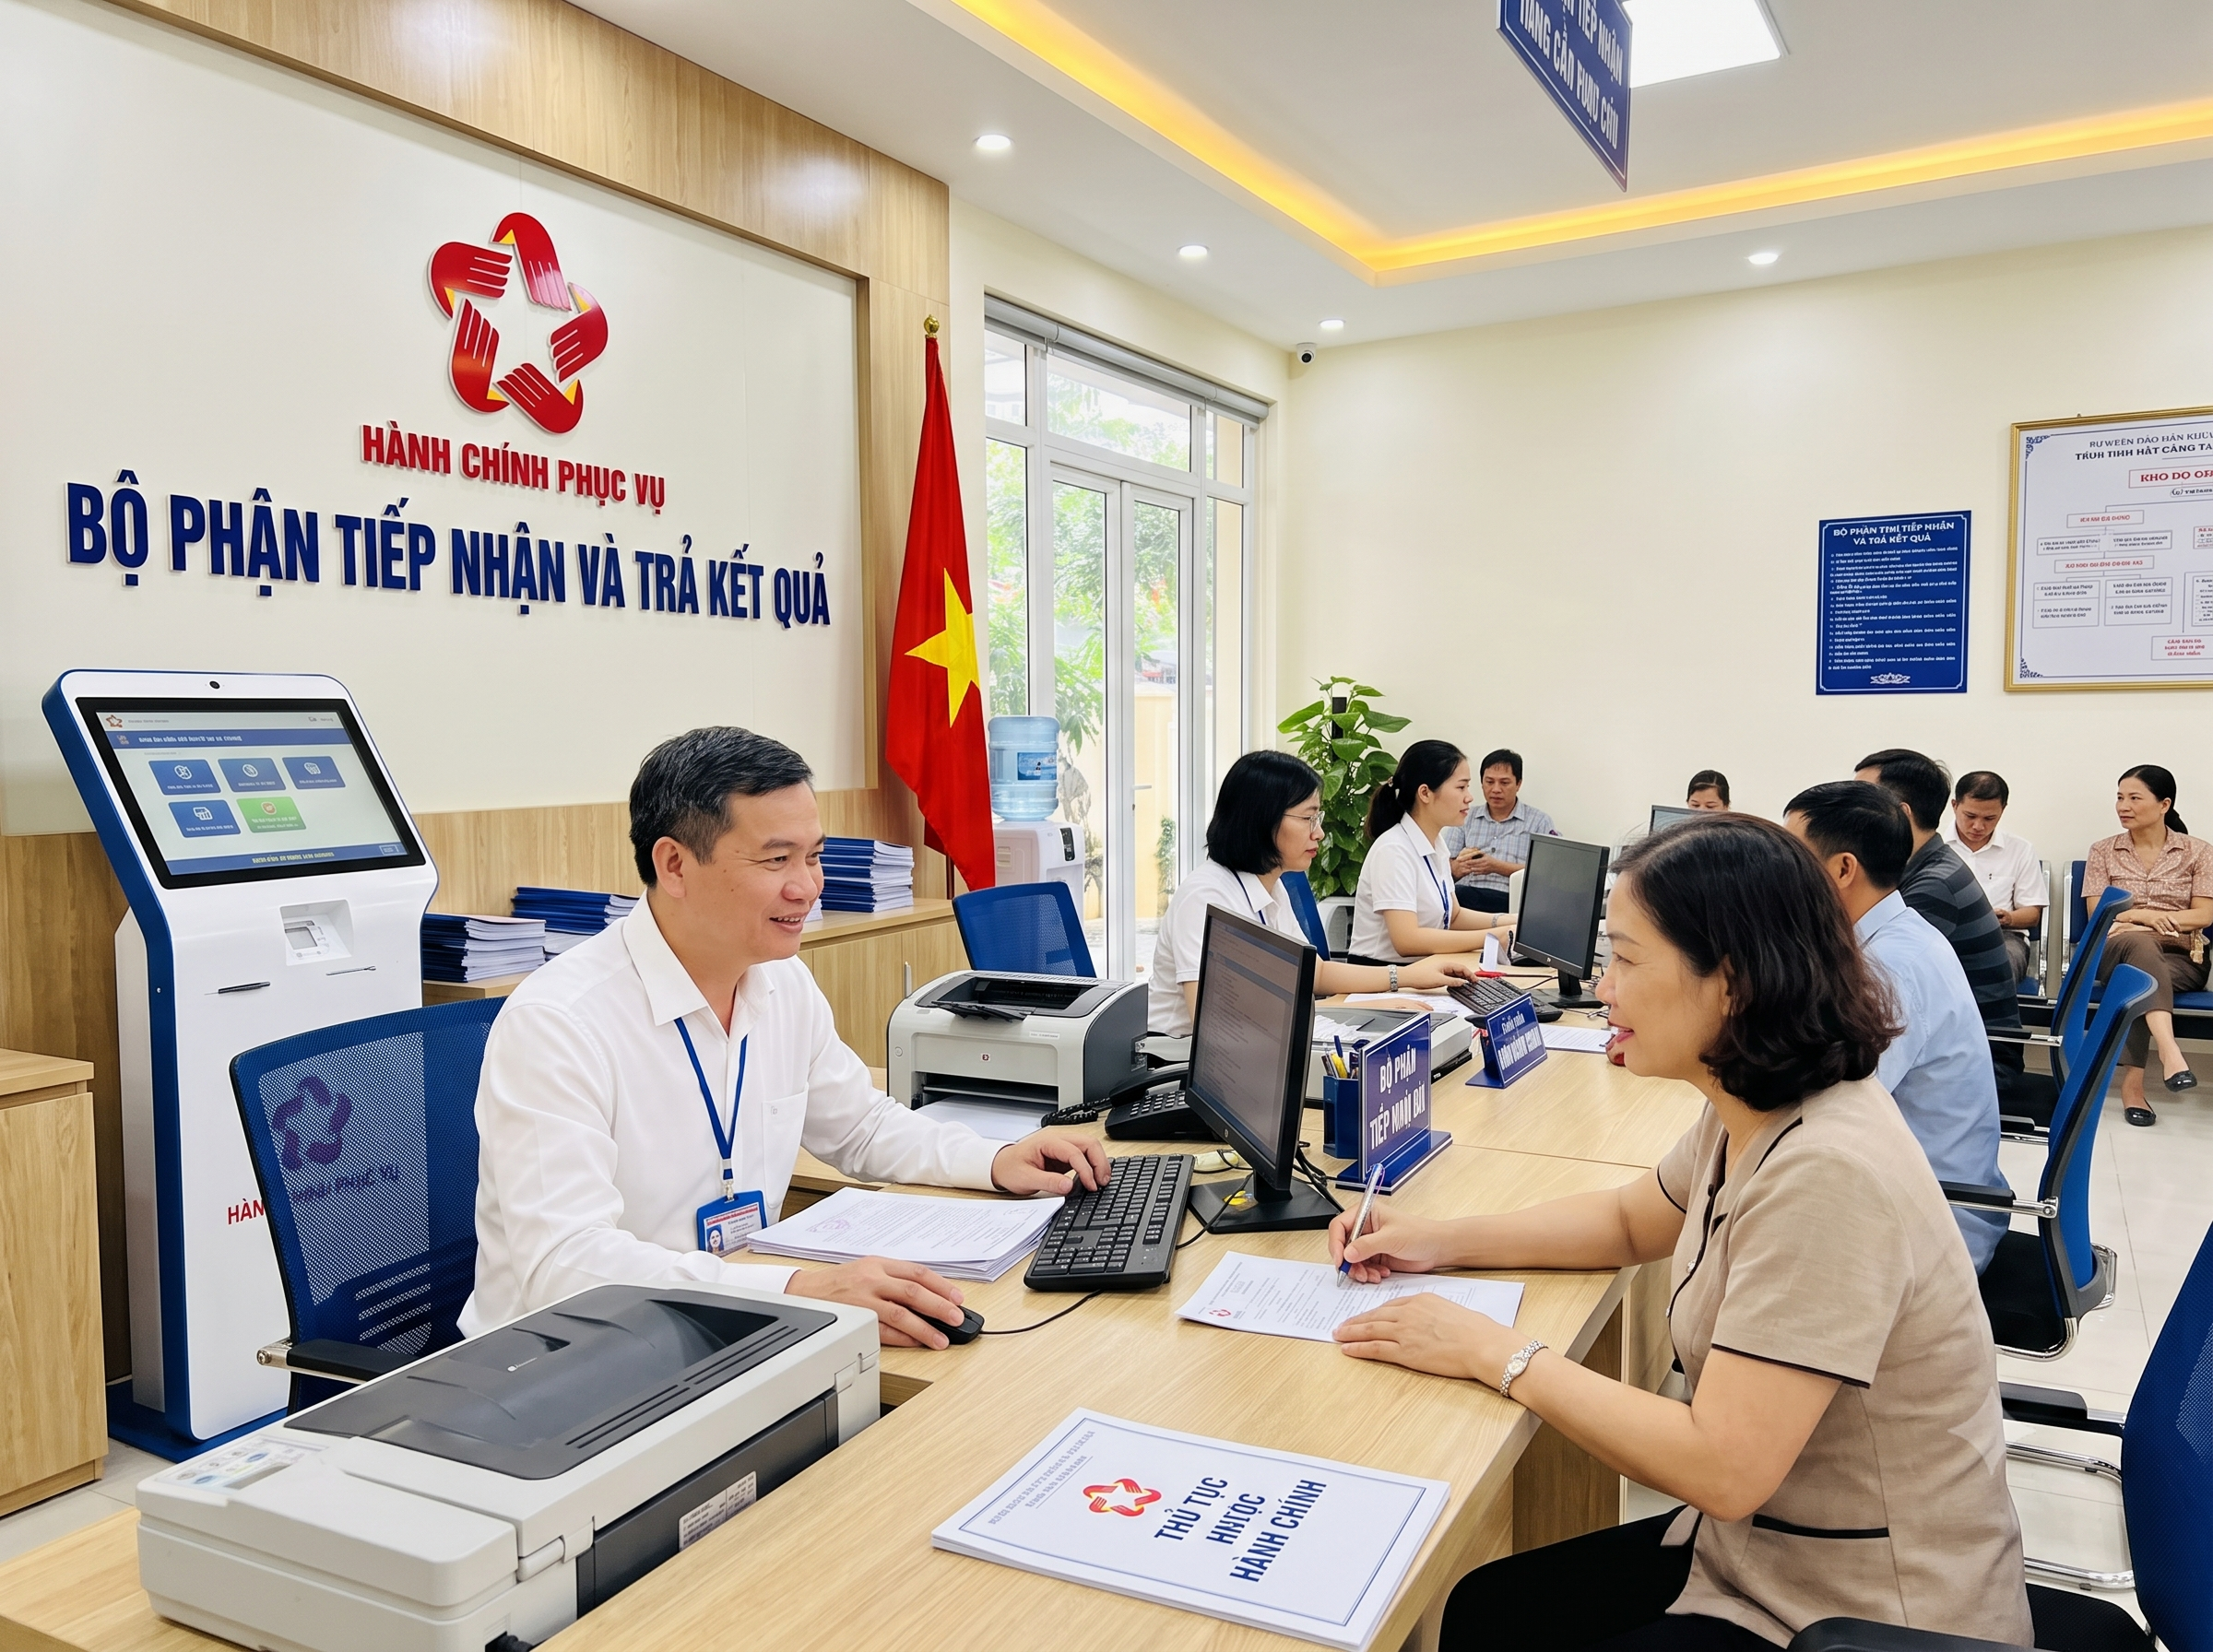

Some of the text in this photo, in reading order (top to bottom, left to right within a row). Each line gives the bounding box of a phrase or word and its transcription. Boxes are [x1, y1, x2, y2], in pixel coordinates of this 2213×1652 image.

[361, 420, 666, 515] HÀNH CHÍNH PHỤC VỤ
[66, 468, 831, 629] BỘ PHẬN TIẾP NHẬN VÀ TRẢ KẾT QUẢ
[228, 1198, 266, 1225] HÀN
[1154, 1477, 1228, 1540] THỦ TỤC
[1229, 1479, 1327, 1583] HÀNH CHÍNH
